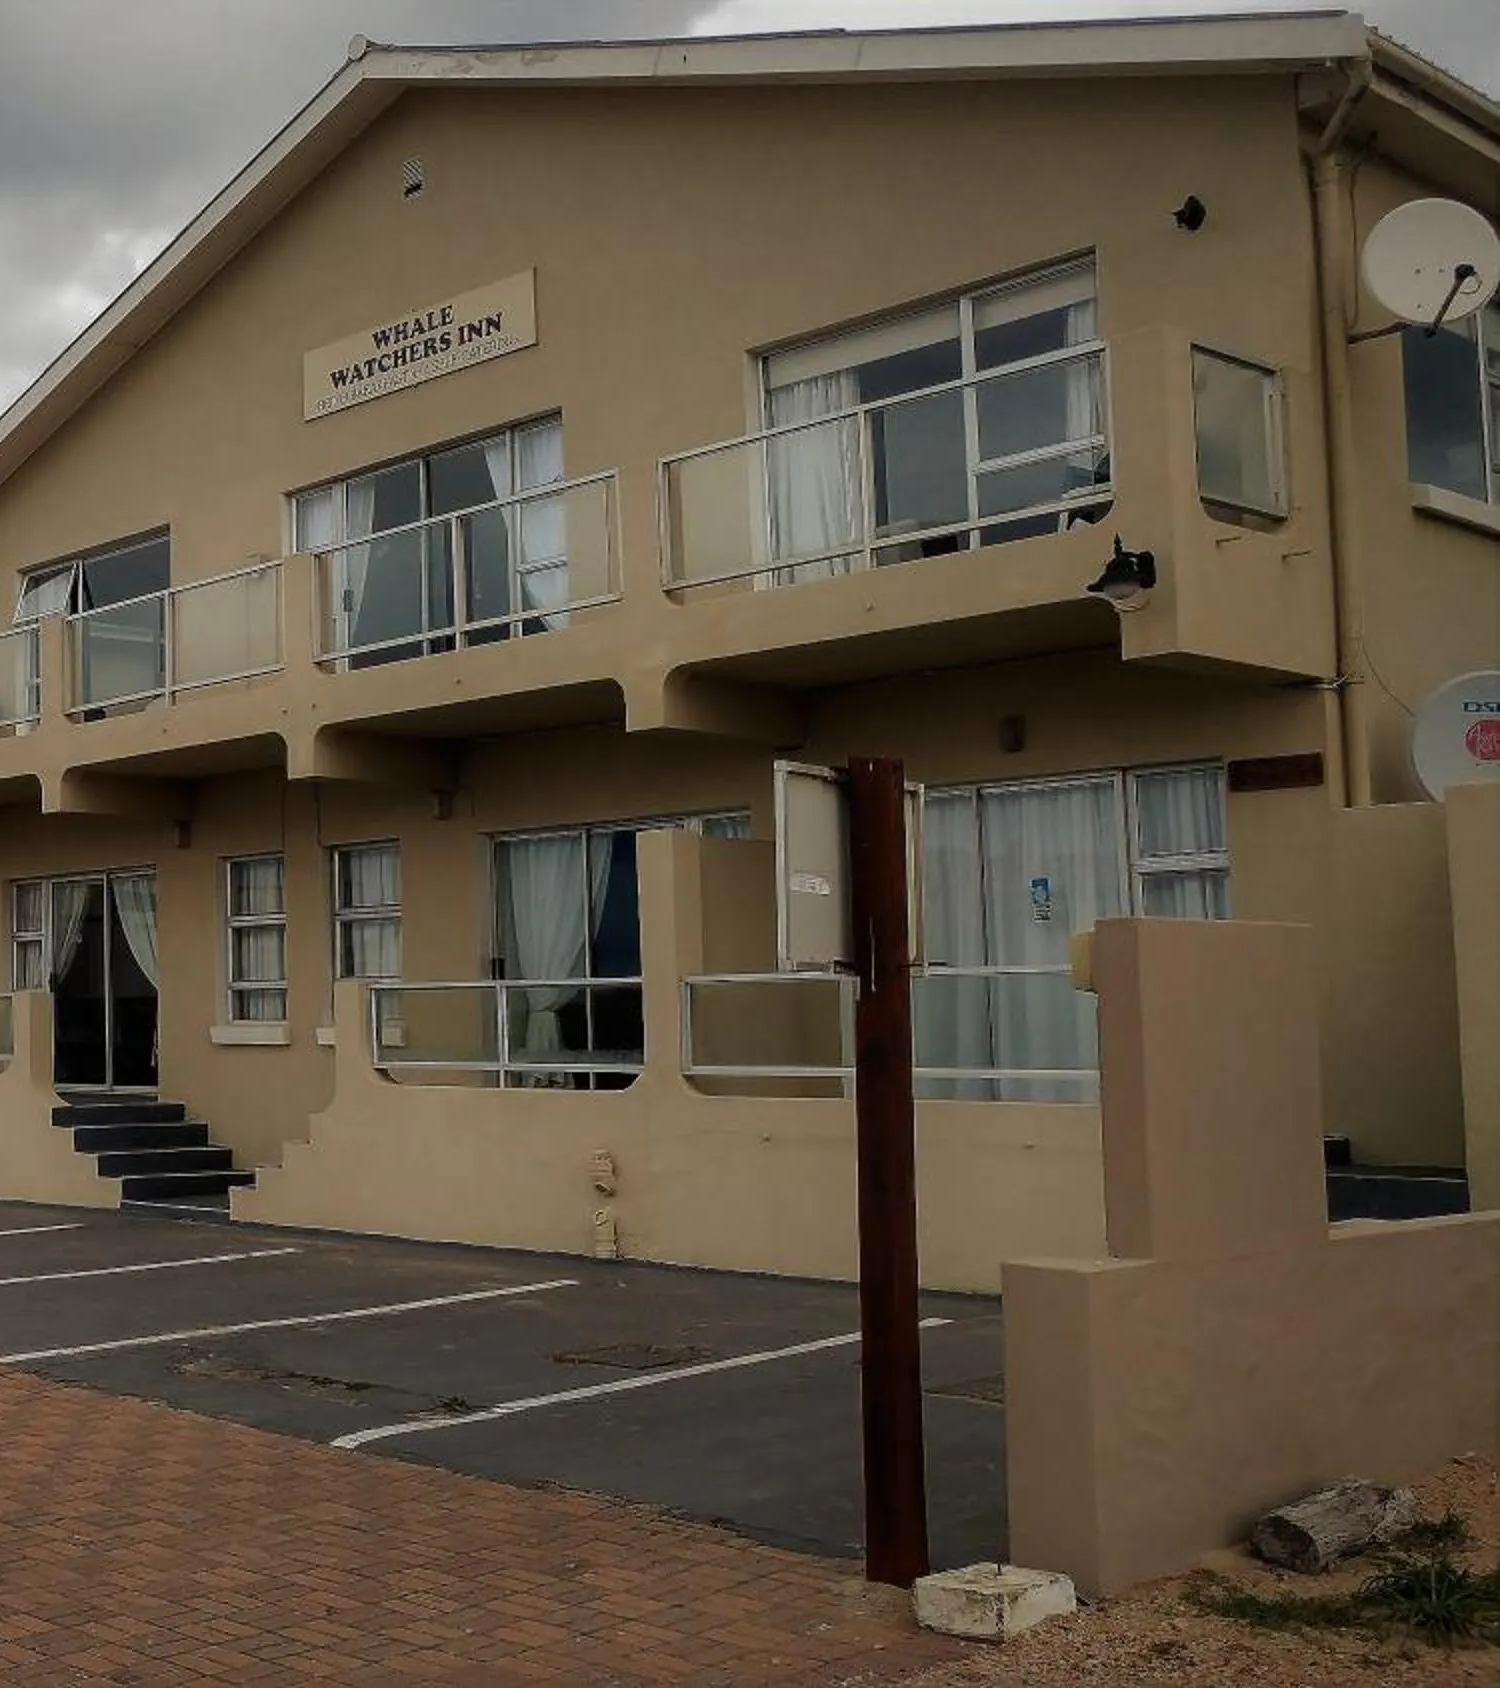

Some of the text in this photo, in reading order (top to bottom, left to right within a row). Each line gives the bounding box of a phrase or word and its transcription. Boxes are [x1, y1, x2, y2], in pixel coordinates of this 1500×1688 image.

[330, 331, 451, 390] WATCHERS
[456, 312, 503, 347] INN
[371, 305, 454, 350] WHALE
